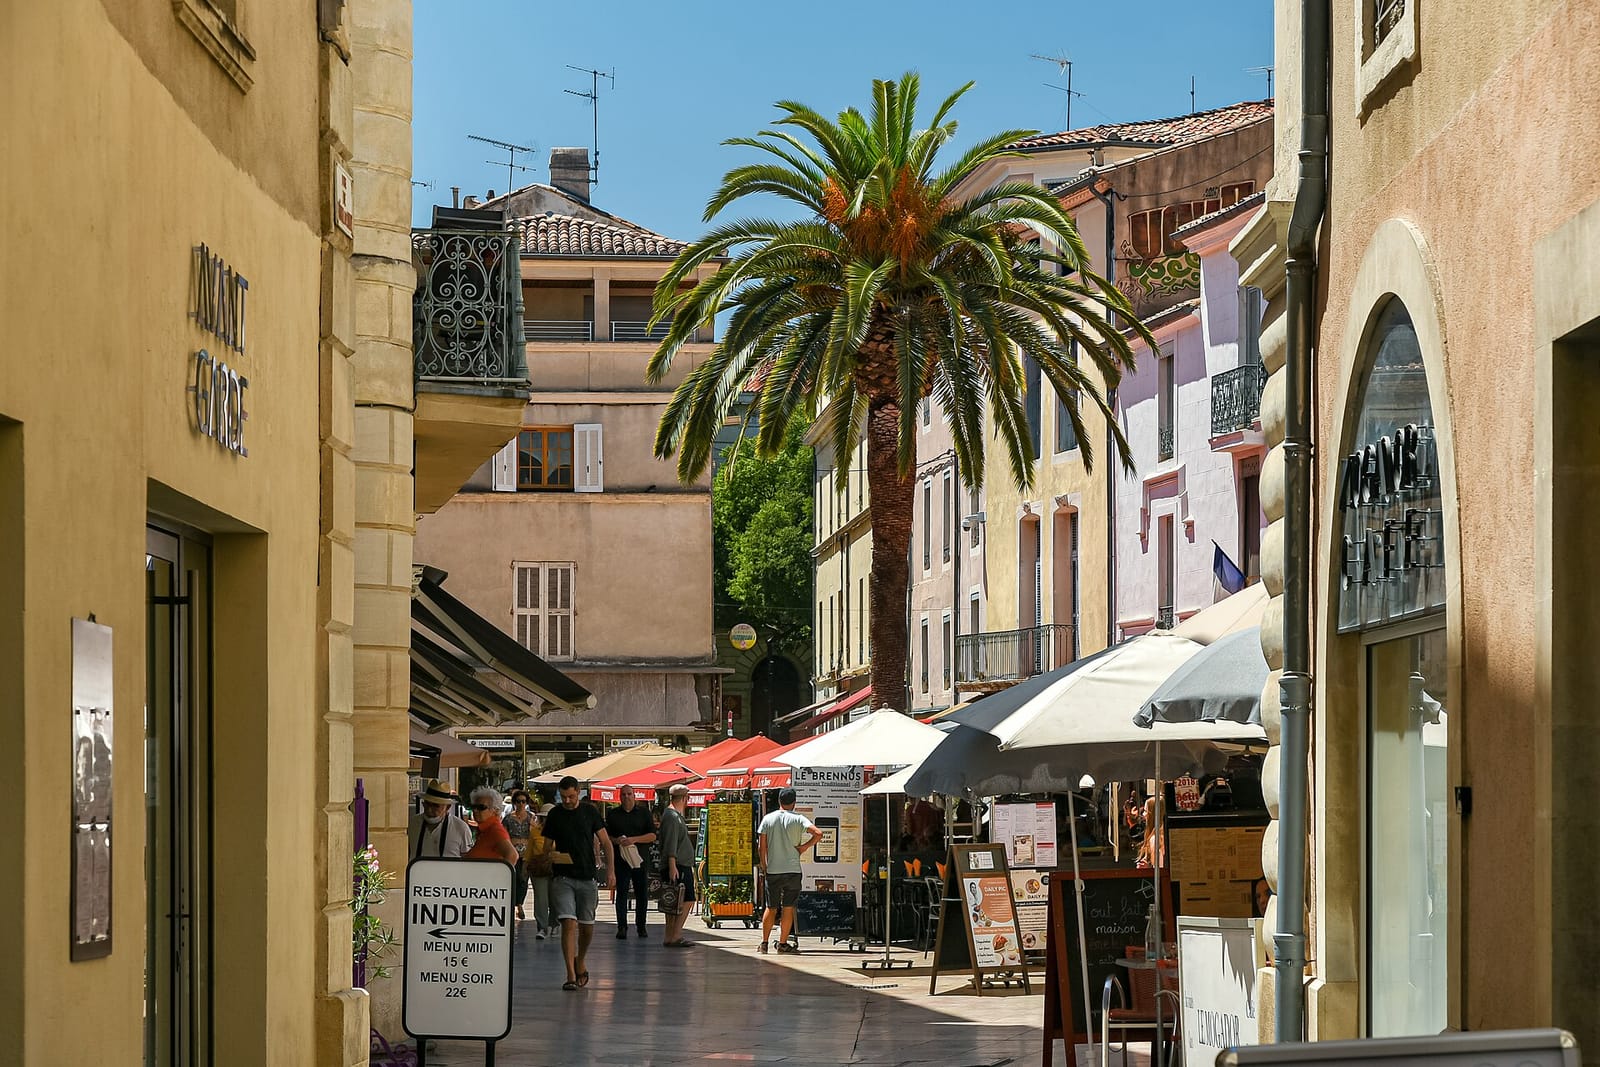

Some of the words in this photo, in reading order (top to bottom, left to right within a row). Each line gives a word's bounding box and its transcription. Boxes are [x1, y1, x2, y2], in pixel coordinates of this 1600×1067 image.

[196, 241, 249, 356] AVANT
[195, 348, 249, 458] GARDE
[795, 771, 807, 781] LE
[413, 886, 508, 900] RESTAURANT
[412, 903, 506, 928] INDIEN
[1095, 922, 1142, 935] maison
[423, 941, 462, 953] MENU
[465, 943, 493, 954] MIDI
[443, 957, 458, 968] 15
[461, 957, 469, 968] €
[420, 972, 458, 984] MENU
[462, 973, 494, 985] SOIR
[445, 987, 467, 998] 22€
